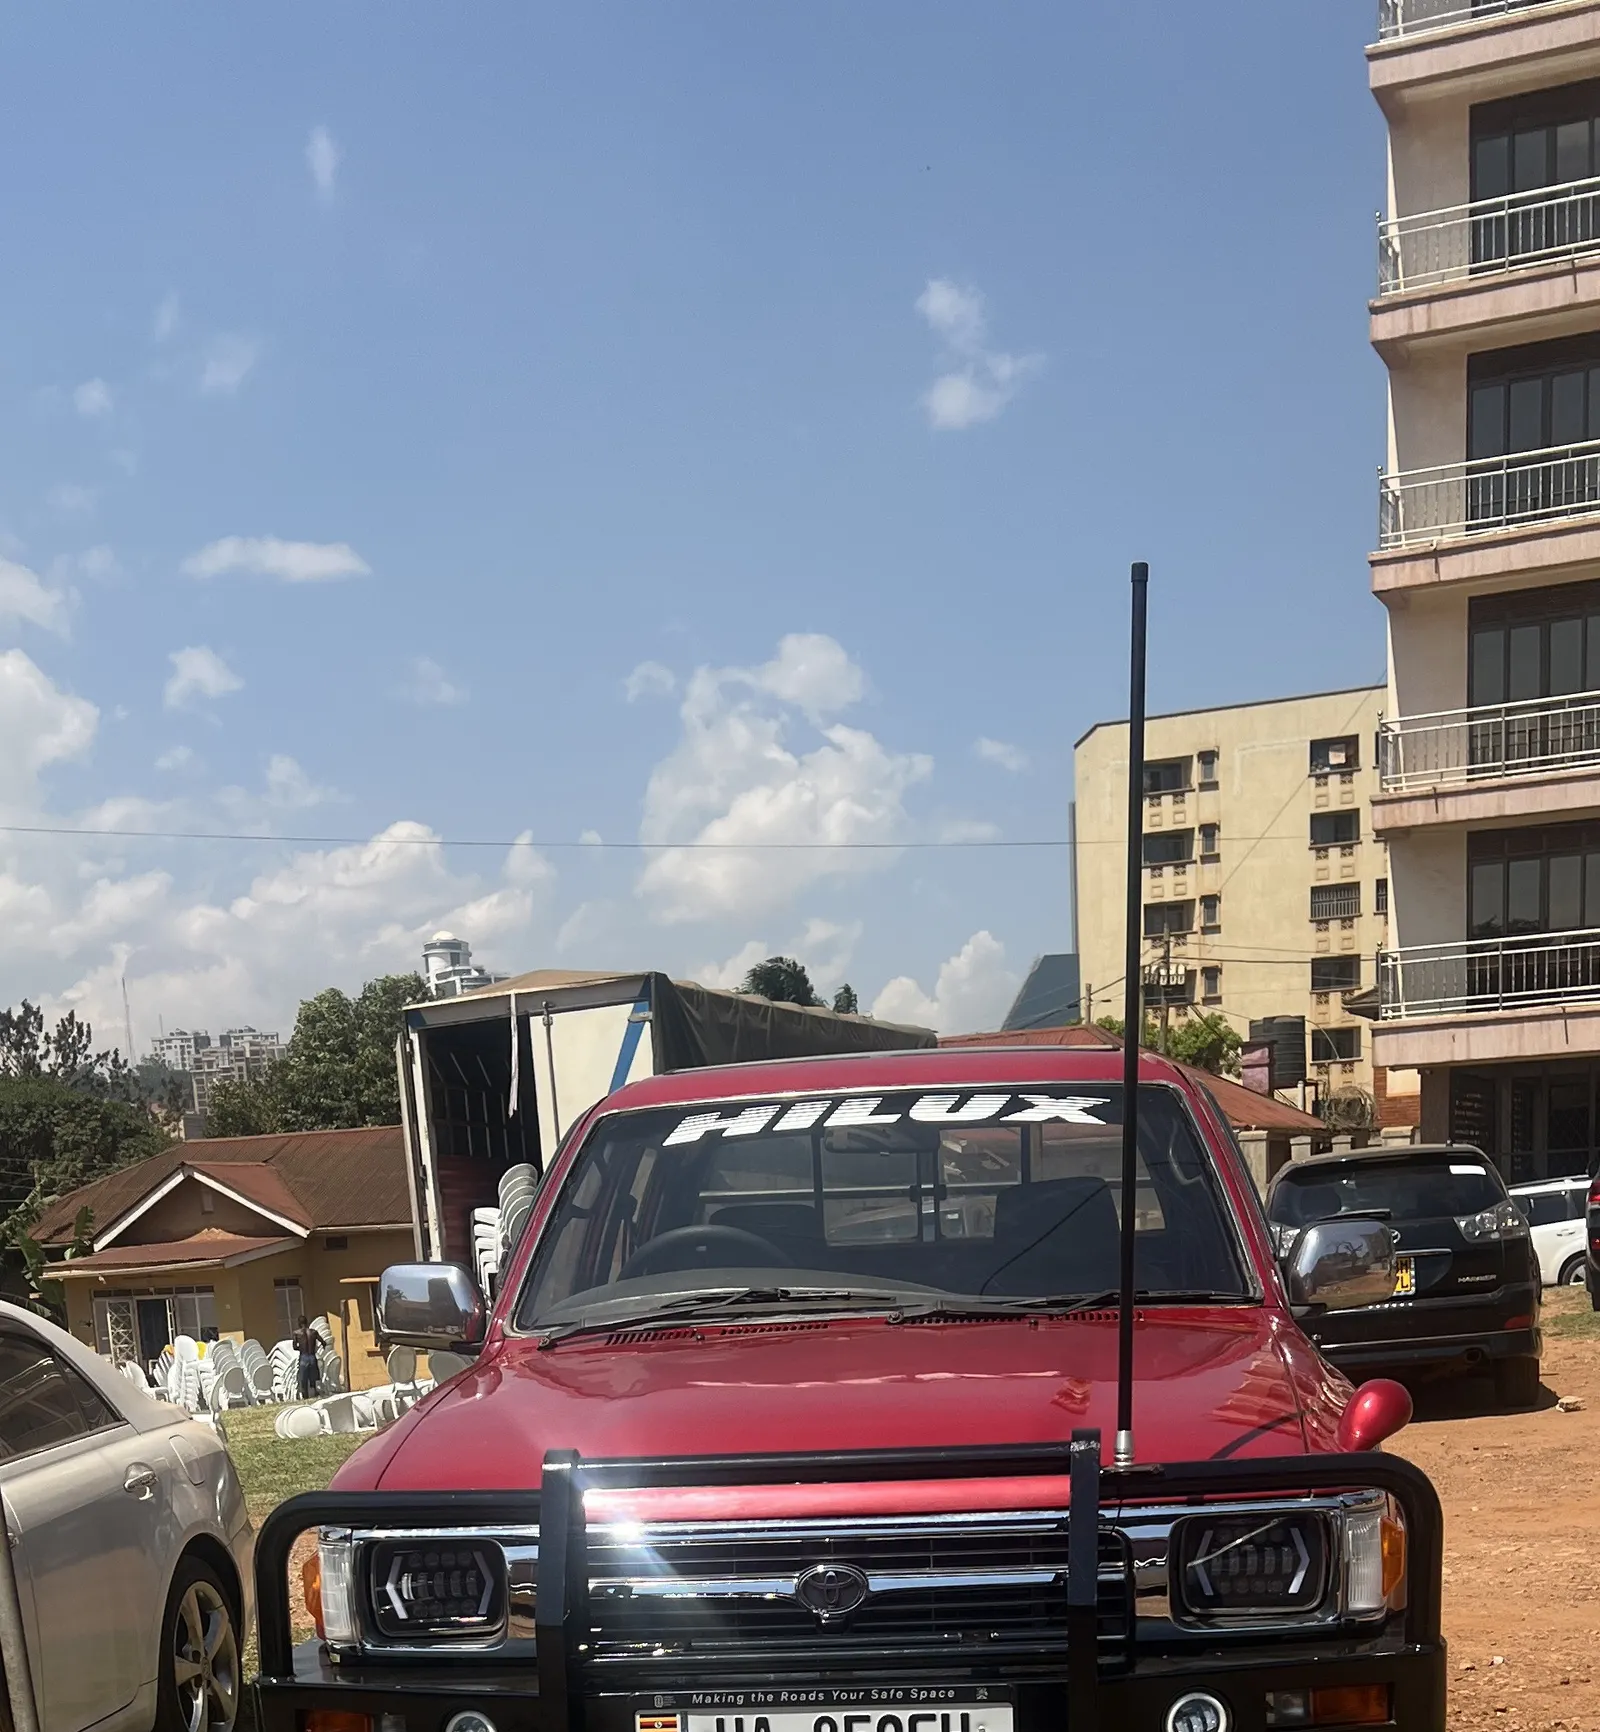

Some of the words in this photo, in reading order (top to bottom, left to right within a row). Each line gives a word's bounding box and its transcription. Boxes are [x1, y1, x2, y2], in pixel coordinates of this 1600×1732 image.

[662, 1094, 1111, 1147] HILUX
[691, 1693, 745, 1705] Making
[751, 1692, 775, 1703] the
[780, 1690, 825, 1702] Roads
[832, 1689, 865, 1701] Your
[871, 1688, 904, 1700] Safe
[910, 1688, 956, 1701] Space
